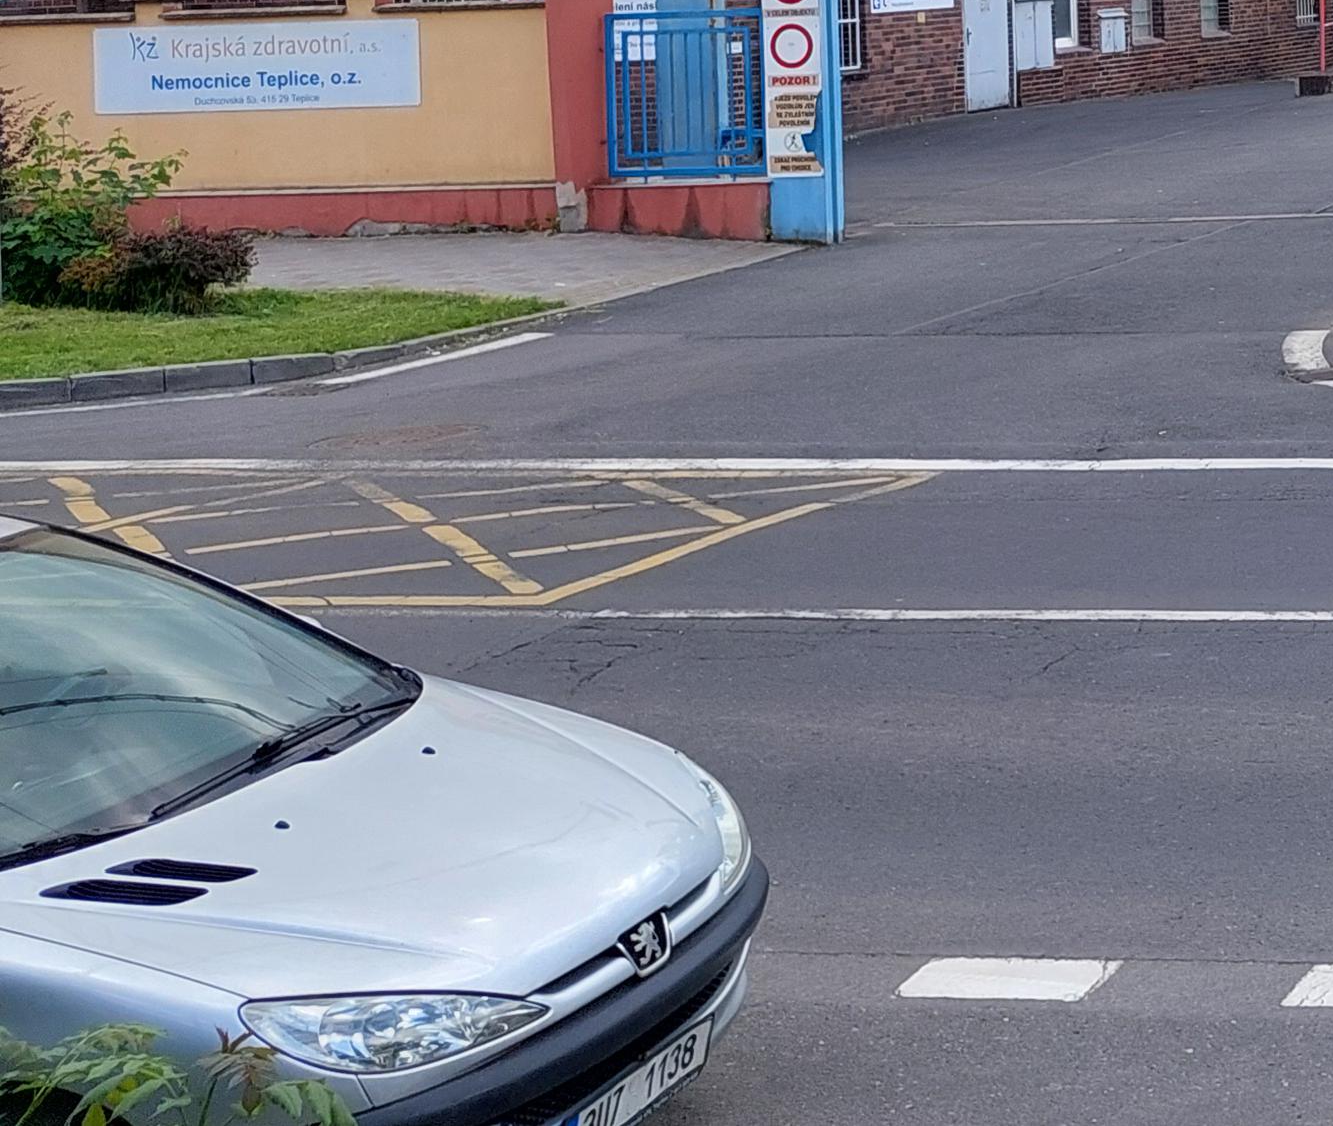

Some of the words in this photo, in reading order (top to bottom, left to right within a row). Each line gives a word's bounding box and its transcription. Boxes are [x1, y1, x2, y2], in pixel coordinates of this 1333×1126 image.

[615, 2, 633, 11] lení
[636, 1, 655, 11] nás
[171, 35, 246, 64] Krajská
[252, 32, 354, 57] zdravotní,
[151, 72, 251, 91] Nemocnice
[256, 70, 324, 91] Teplice,
[330, 71, 362, 85] o.z.
[772, 76, 810, 86] POZOR
[645, 1034, 697, 1099] 1138
